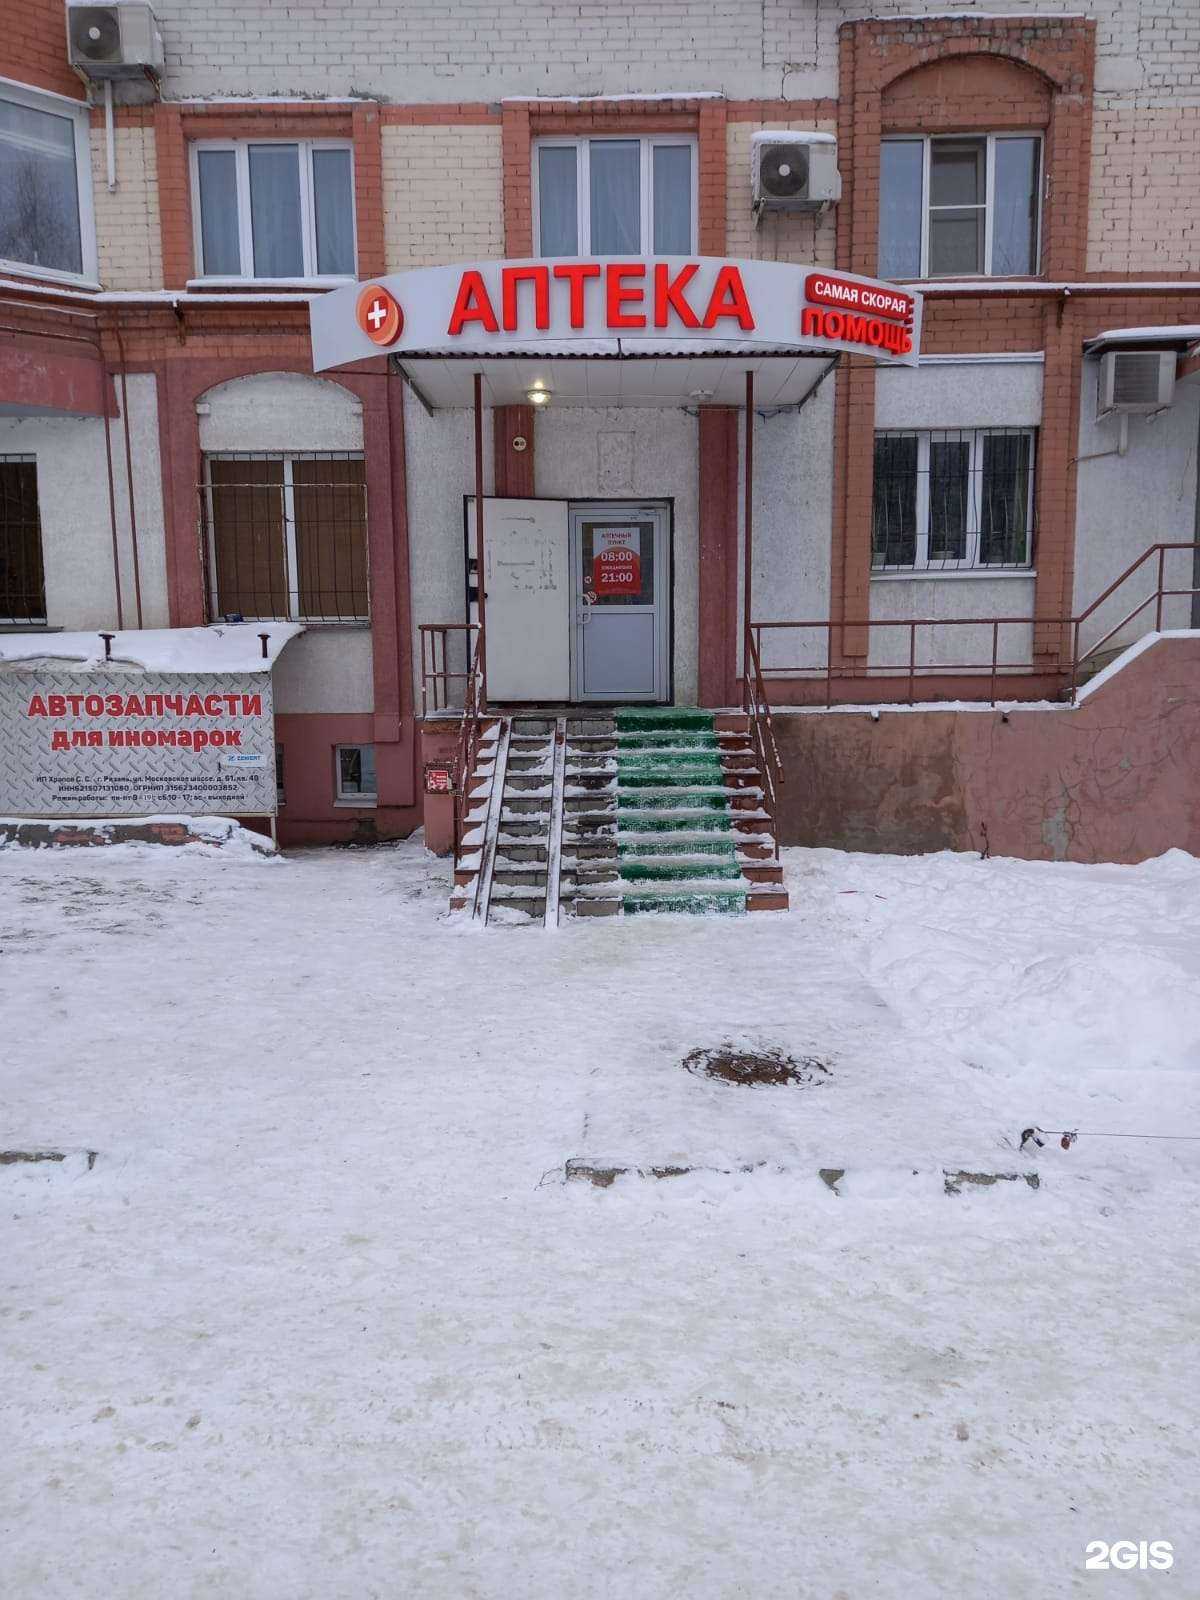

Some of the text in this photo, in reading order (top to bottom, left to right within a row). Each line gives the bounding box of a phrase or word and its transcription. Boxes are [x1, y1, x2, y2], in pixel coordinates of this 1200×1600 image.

[447, 263, 756, 336] АПТЕКА
[814, 281, 906, 313] САМАЯ СКОРАЯ
[801, 307, 913, 355] ПОМОЩЬ
[601, 552, 633, 561] 08:00
[601, 572, 633, 582] 21:00
[28, 694, 262, 717] АВТОЗАПЧАСТИ
[108, 729, 242, 752] иномарок
